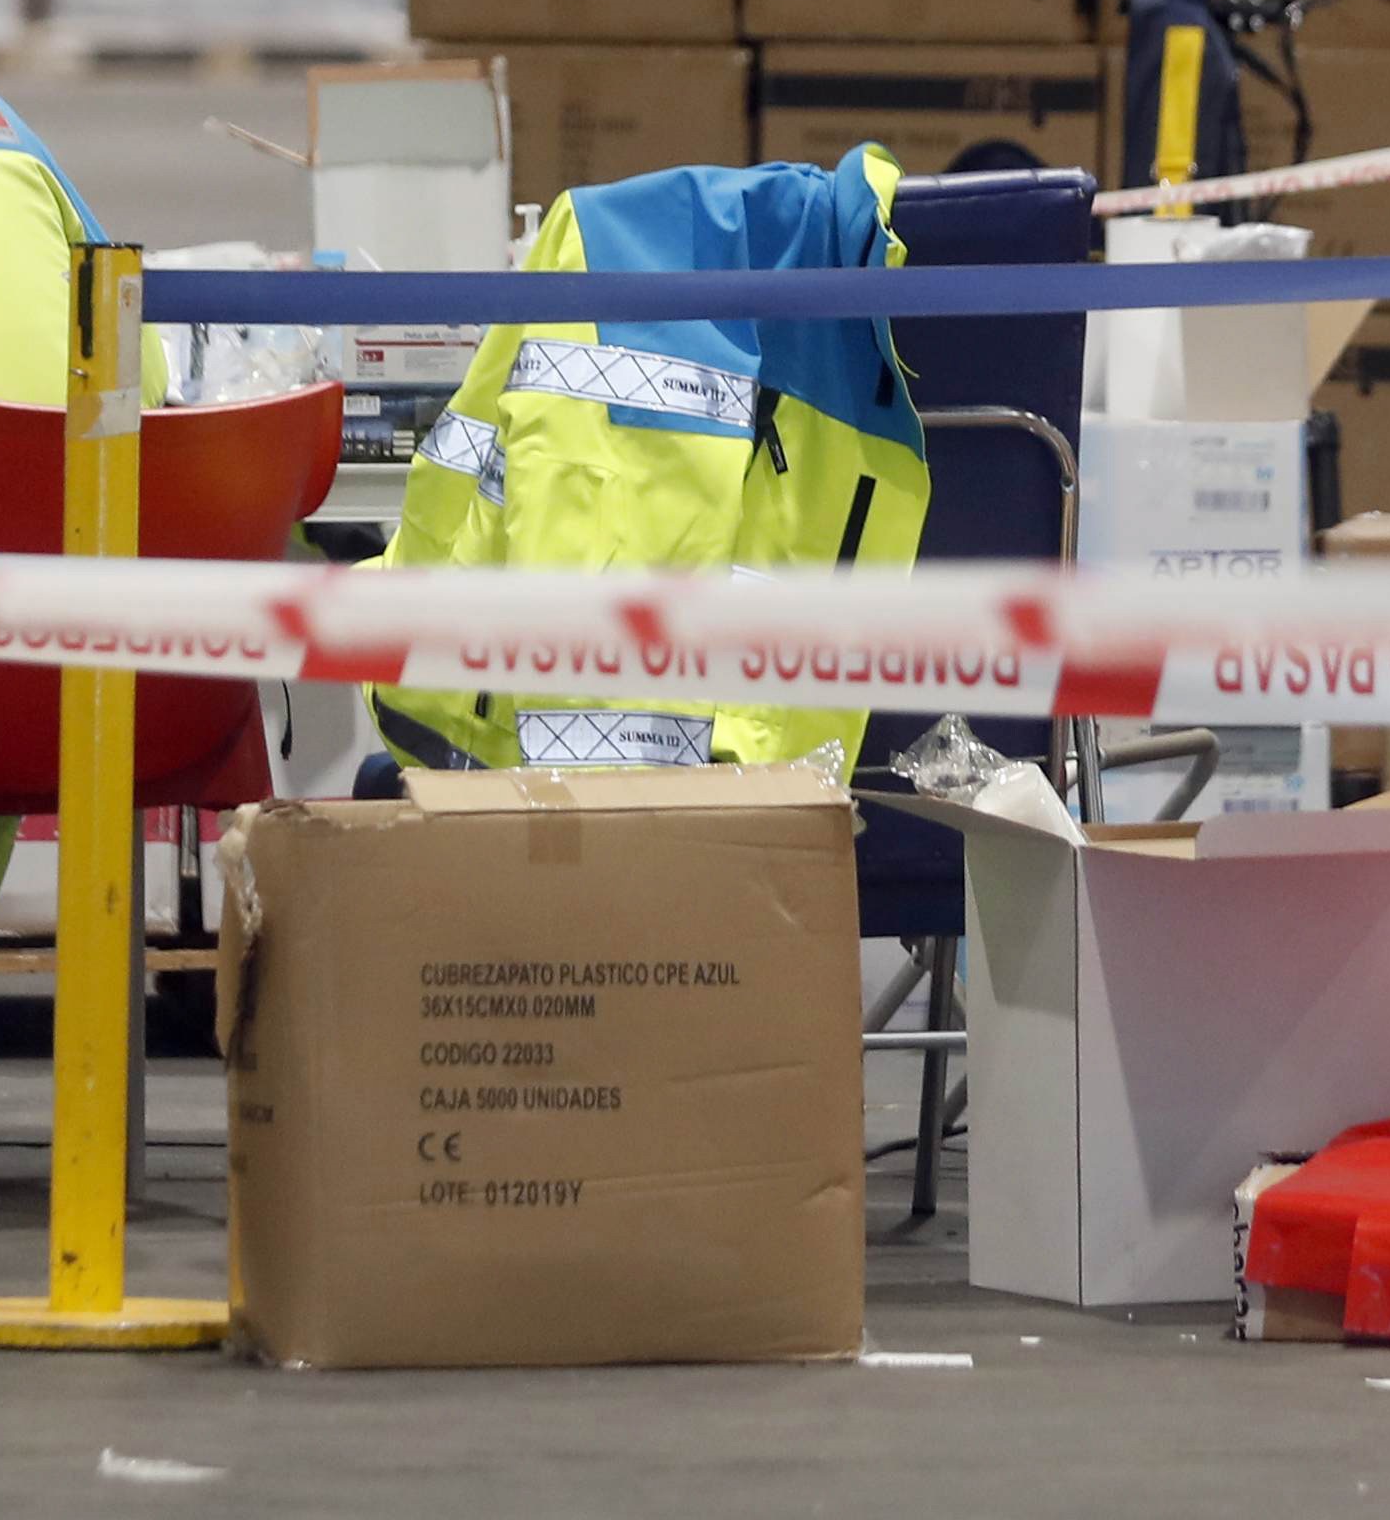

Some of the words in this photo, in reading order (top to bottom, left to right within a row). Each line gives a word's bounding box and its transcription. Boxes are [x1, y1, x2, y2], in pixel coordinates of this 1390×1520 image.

[662, 377, 706, 398] SUMMA
[1152, 550, 1283, 580] APTOR
[1215, 634, 1375, 696] PASAR
[619, 730, 664, 747] SUMMA
[420, 962, 554, 986] CUBREZAPATO
[559, 962, 649, 986] PLASTICO
[652, 962, 690, 985] CPE
[693, 962, 741, 986] AZUL
[419, 1041, 497, 1066] CODIGO
[501, 1041, 555, 1066] 22033
[419, 1086, 471, 1110] CAJA
[476, 1086, 518, 1110] 5000
[522, 1086, 622, 1111] UNIDADES
[484, 1180, 584, 1207] 012019Y
